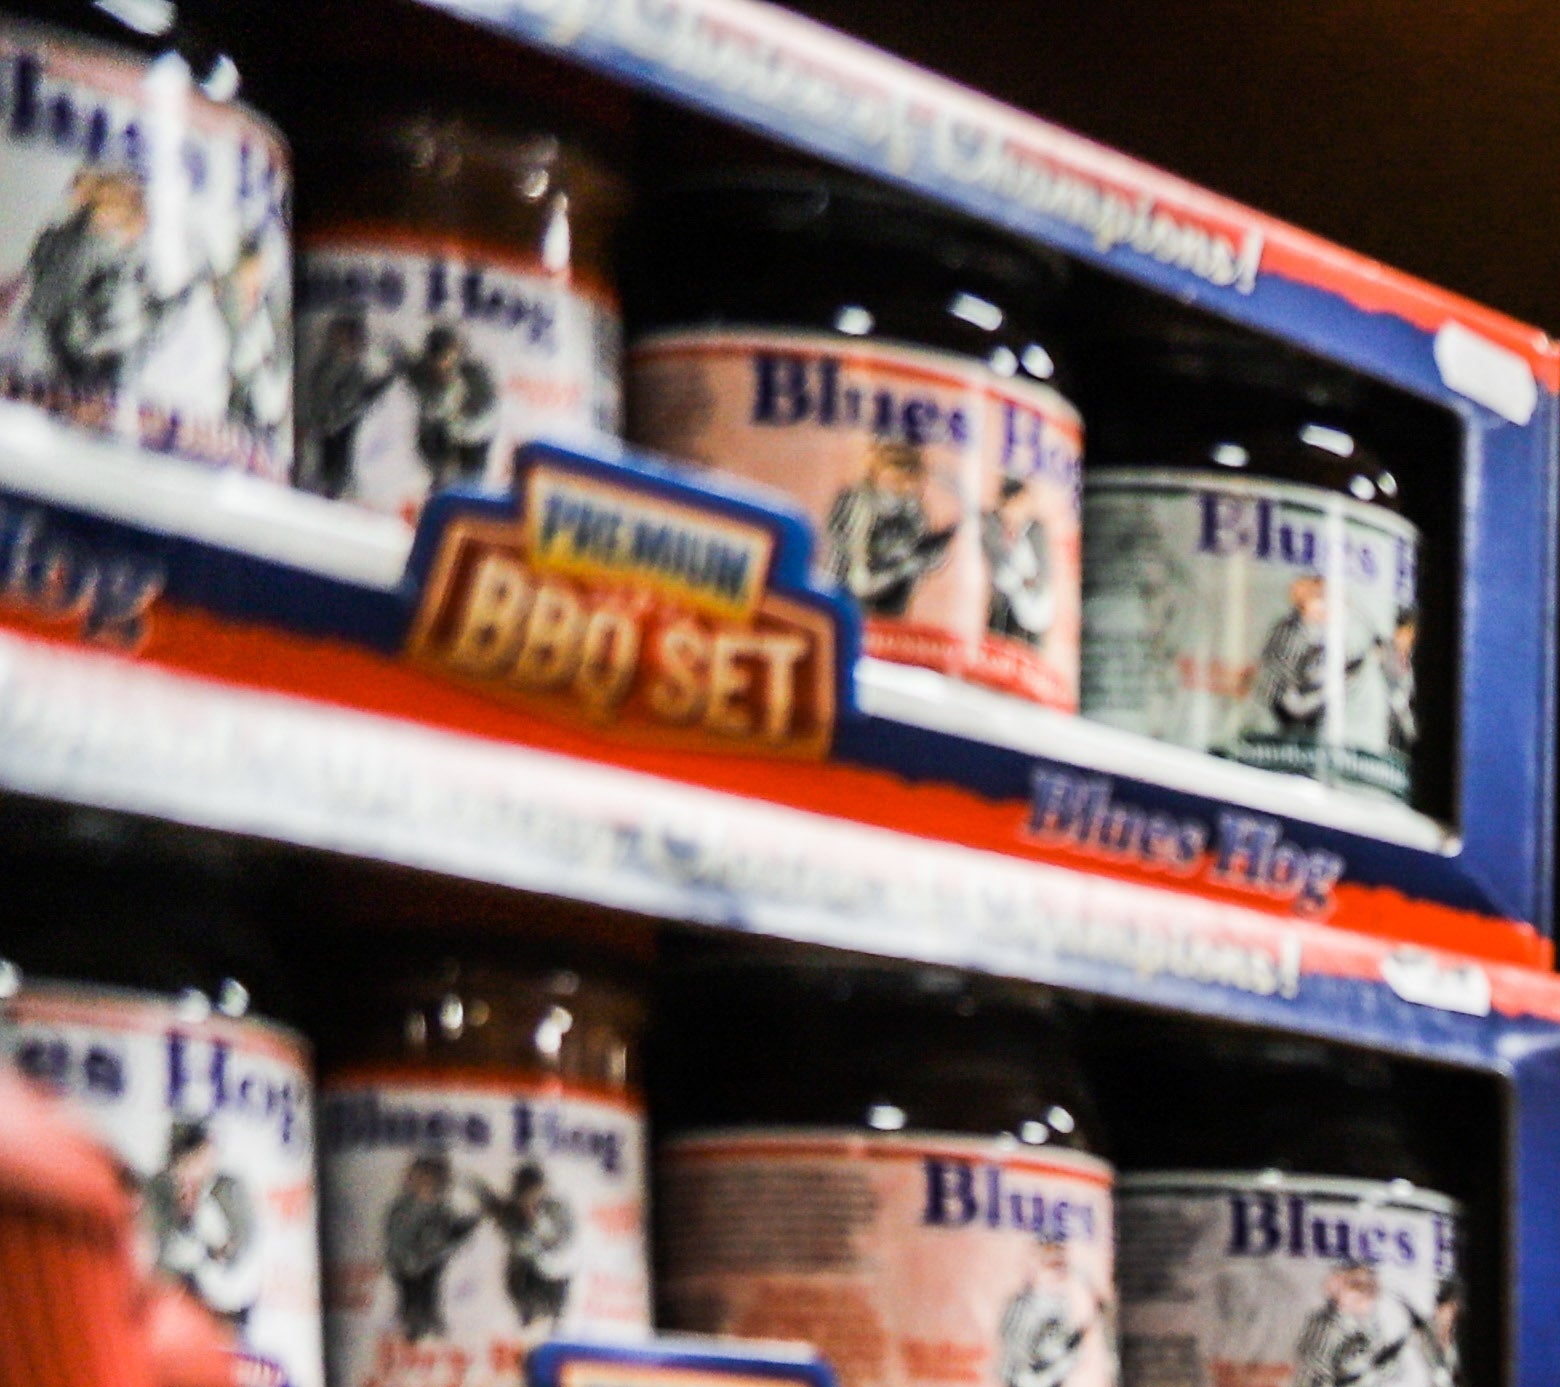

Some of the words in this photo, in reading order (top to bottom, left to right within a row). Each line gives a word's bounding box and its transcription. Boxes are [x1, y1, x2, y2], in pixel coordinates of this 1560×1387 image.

[472, 558, 640, 702] BBQ
[650, 627, 802, 744] SET
[1023, 768, 1208, 872] Blues
[1212, 809, 1345, 916] Hog
[1228, 1197, 1418, 1264] Blues
